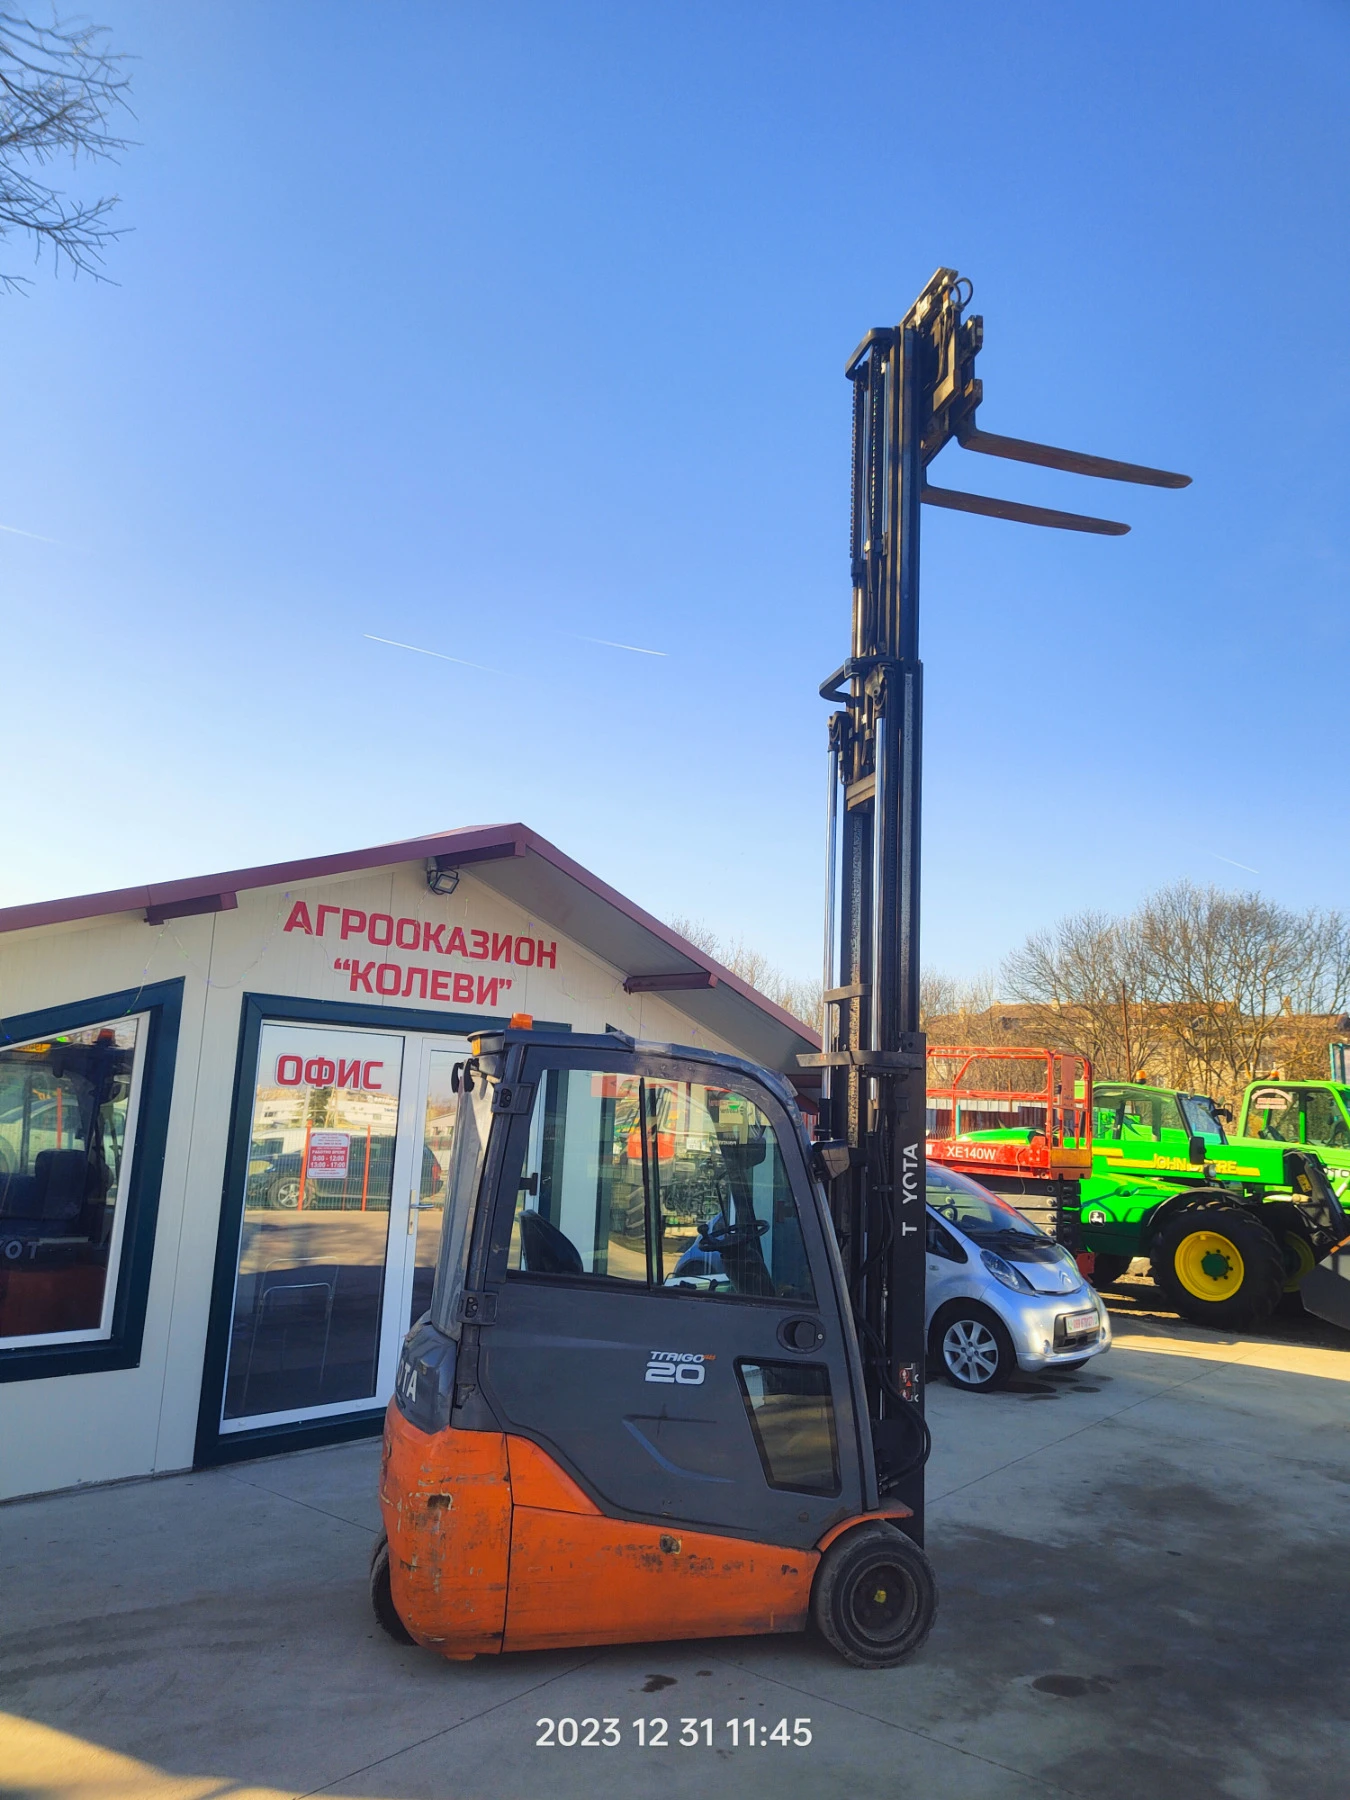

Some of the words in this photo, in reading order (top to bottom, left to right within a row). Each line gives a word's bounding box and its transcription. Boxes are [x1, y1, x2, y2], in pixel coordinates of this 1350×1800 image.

[283, 900, 557, 969] АГРООКАЗИОН
[277, 1055, 384, 1089] ОФИС
[946, 1146, 996, 1160] XE140W
[1153, 1153, 1187, 1171] JOHN
[650, 1351, 704, 1363] TRAIGO
[645, 1361, 705, 1384] 20
